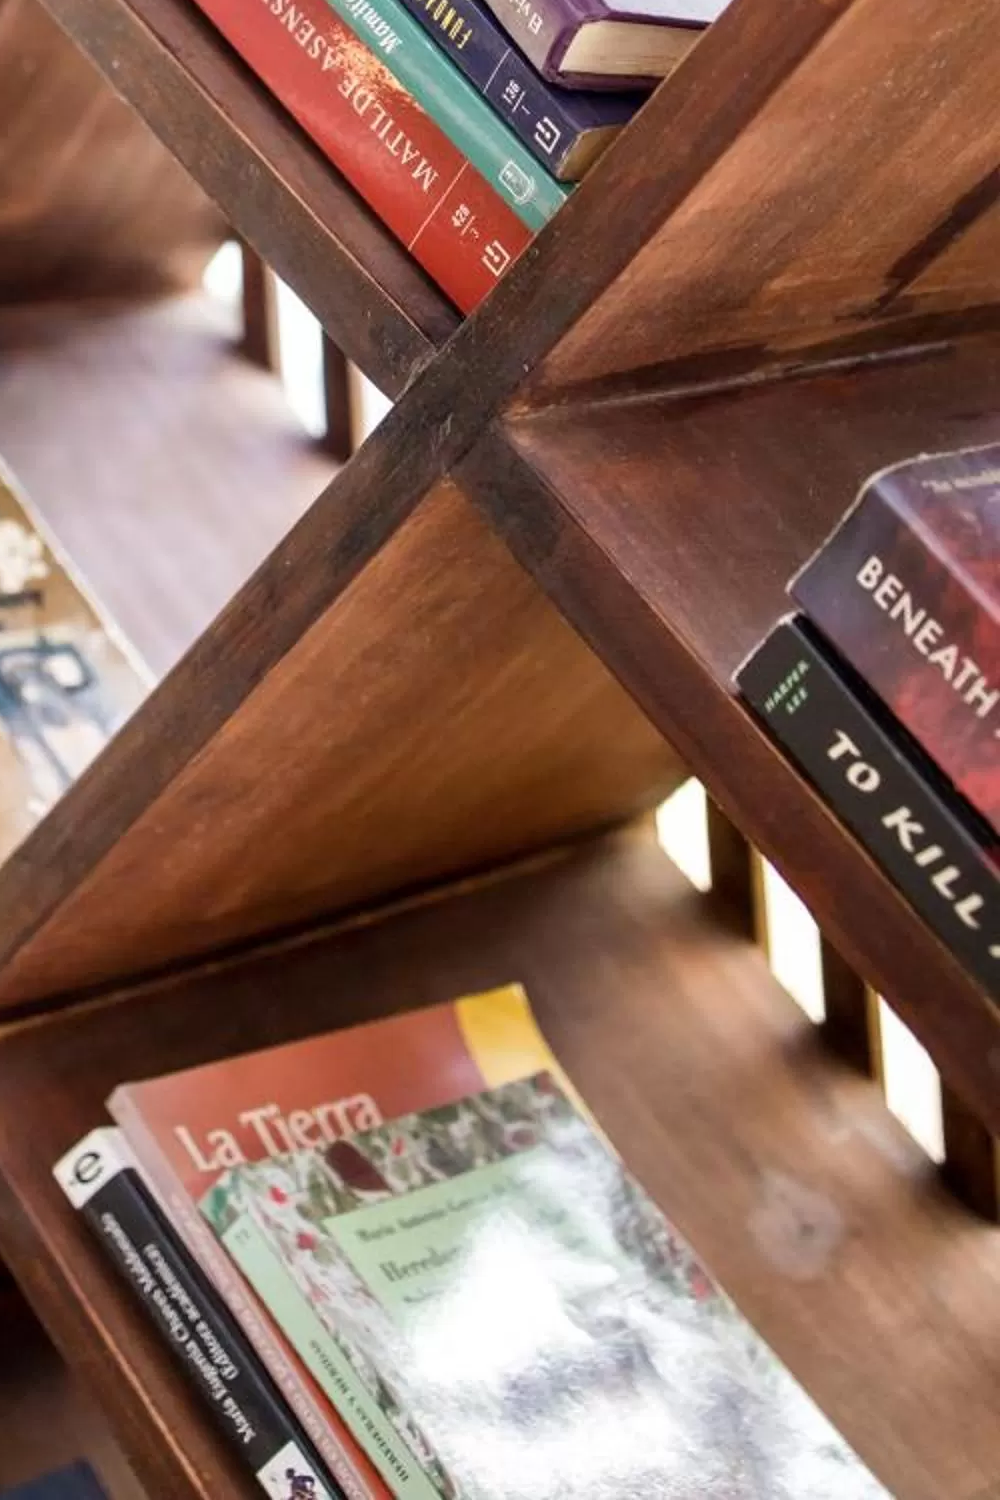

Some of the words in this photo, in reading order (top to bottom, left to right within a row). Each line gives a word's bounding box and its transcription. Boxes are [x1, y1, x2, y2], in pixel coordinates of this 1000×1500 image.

[527, 11, 543, 35] El
[337, 73, 439, 192] MATILDE
[855, 554, 1000, 721] BENEATH
[763, 661, 811, 714] HARPER
[785, 690, 809, 717] LEE
[825, 728, 882, 793] TO
[882, 804, 984, 930] KILL
[173, 1125, 246, 1172] La
[238, 1093, 384, 1156] Tierra
[184, 1338, 228, 1400] Eugenia
[195, 1319, 239, 1380] (Editora
[222, 1395, 256, 1444] María
